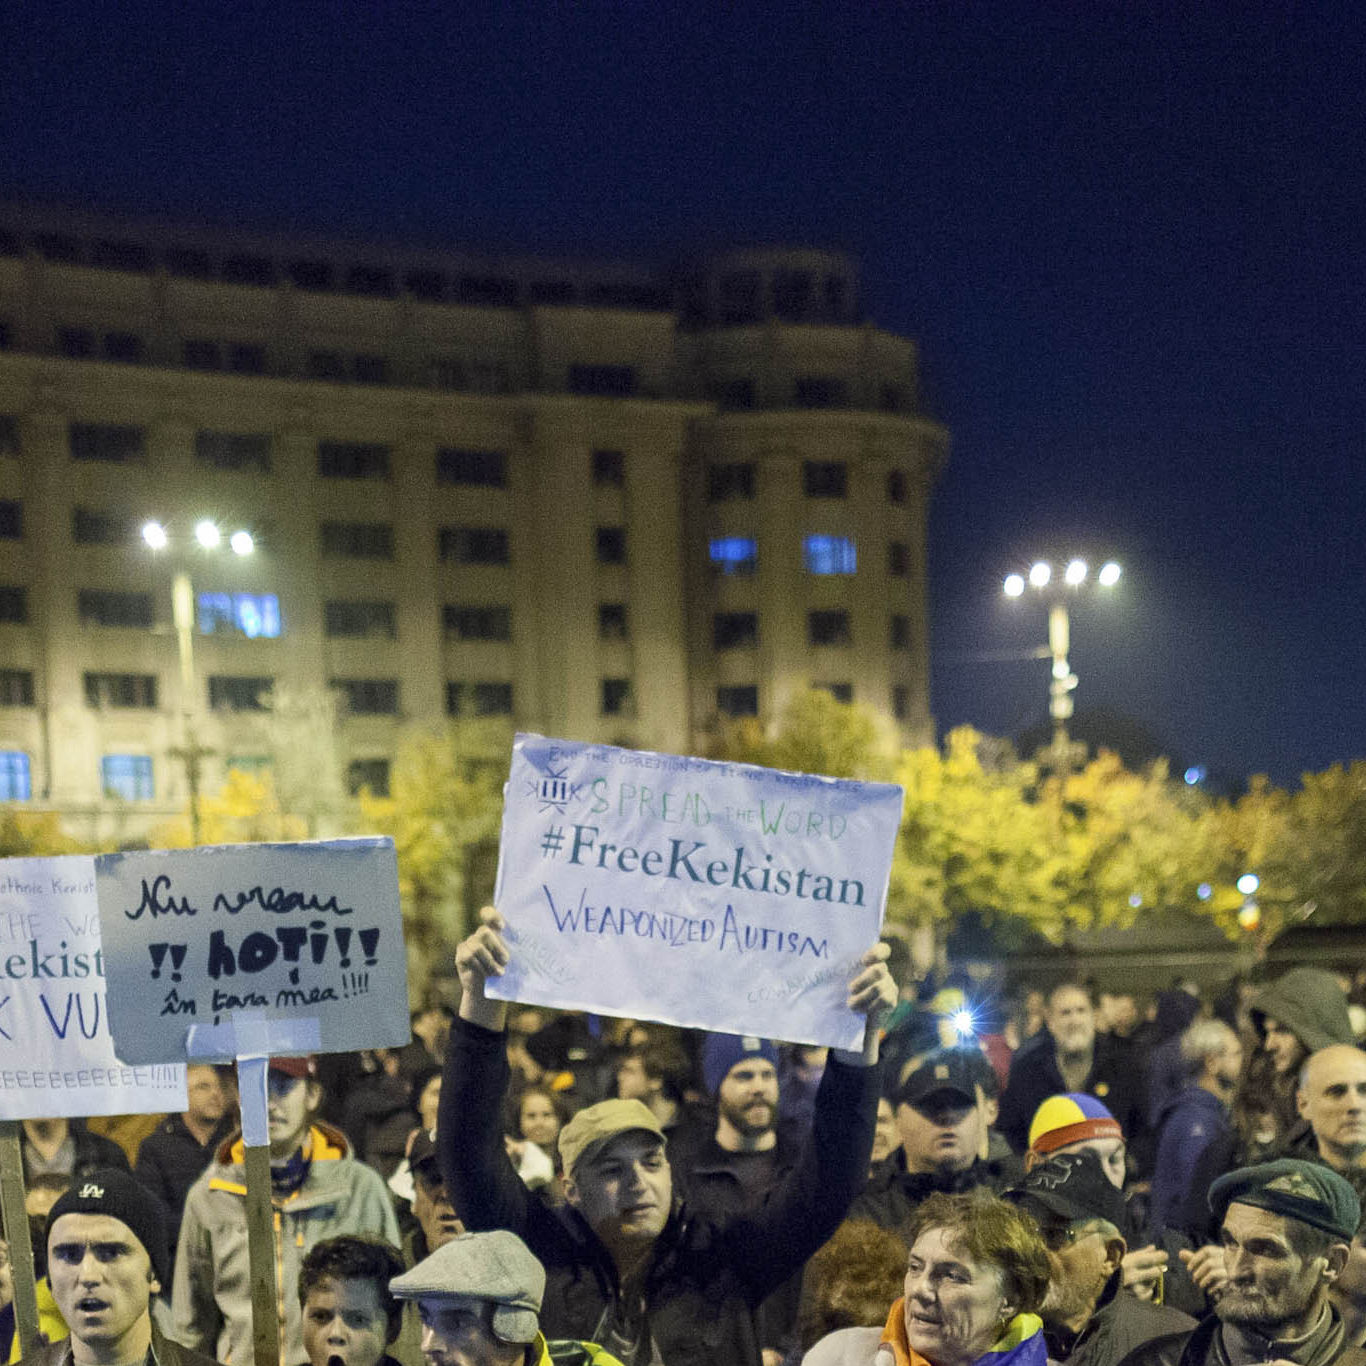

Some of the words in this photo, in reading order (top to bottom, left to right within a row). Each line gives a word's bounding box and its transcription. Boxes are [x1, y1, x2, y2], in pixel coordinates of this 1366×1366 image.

[591, 777, 712, 826] SPREAD
[725, 806, 755, 825] THE
[760, 799, 848, 841] WORD
[124, 874, 198, 920] Nu
[212, 886, 354, 915] vreau
[540, 823, 867, 908] #FreeKekistan
[543, 884, 715, 947] WEAPONIZED
[719, 903, 829, 960] AUTISM
